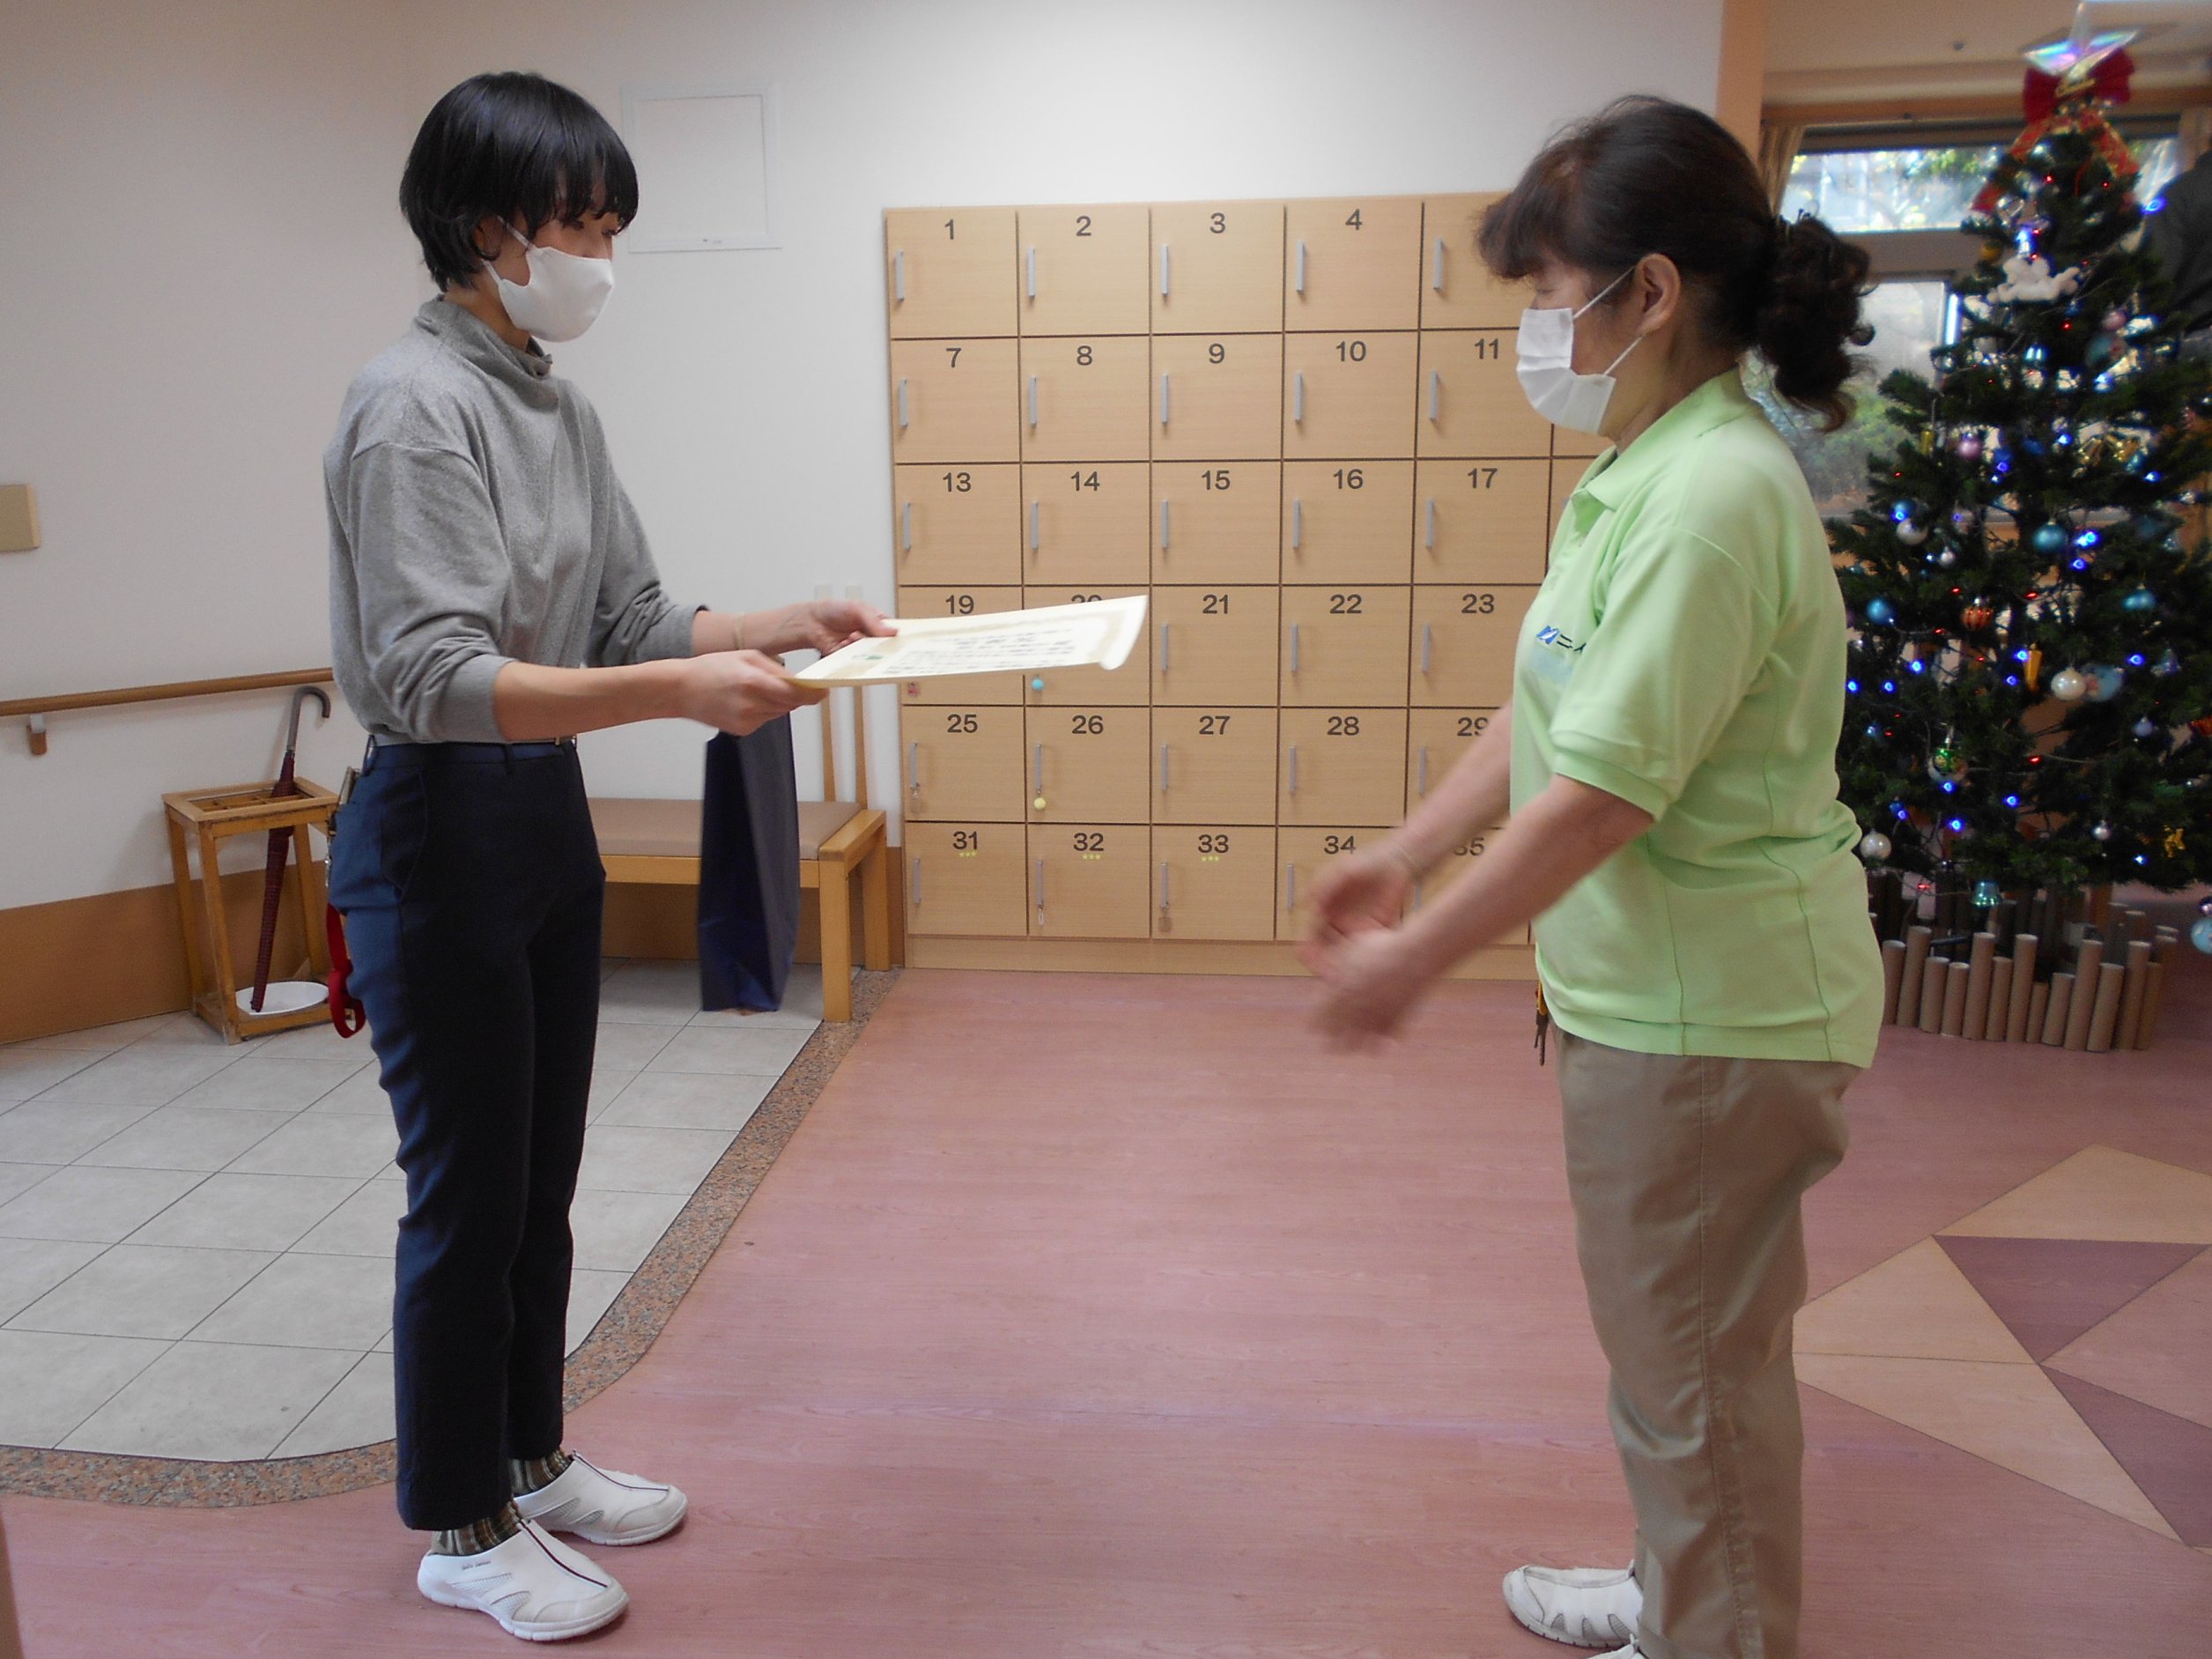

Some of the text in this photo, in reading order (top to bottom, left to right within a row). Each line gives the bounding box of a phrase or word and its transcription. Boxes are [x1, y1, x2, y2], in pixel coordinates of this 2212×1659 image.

[944, 218, 955, 241] 1
[1076, 215, 1092, 237] 2
[1210, 212, 1226, 234] 3
[1344, 208, 1363, 231] 4
[945, 347, 962, 368] 7
[1076, 344, 1093, 367] 8
[1208, 343, 1225, 365] 9
[1335, 340, 1367, 362] 10
[1474, 337, 1499, 360] 11
[942, 471, 973, 493] 13
[1070, 470, 1100, 492] 14
[1201, 470, 1231, 491] 15
[1333, 468, 1364, 490] 16
[1467, 467, 1498, 489] 17
[945, 594, 974, 615] 19
[1202, 594, 1229, 615] 21
[1329, 594, 1363, 614] 22
[1461, 593, 1495, 615] 23
[947, 714, 979, 734] 25
[1071, 715, 1104, 735] 26
[1198, 715, 1231, 736] 27
[1327, 715, 1360, 737] 28
[1456, 716, 1490, 737] 29
[952, 831, 978, 850] 31
[1073, 832, 1105, 852] 32
[1197, 833, 1230, 854] 33
[1323, 835, 1357, 855] 34
